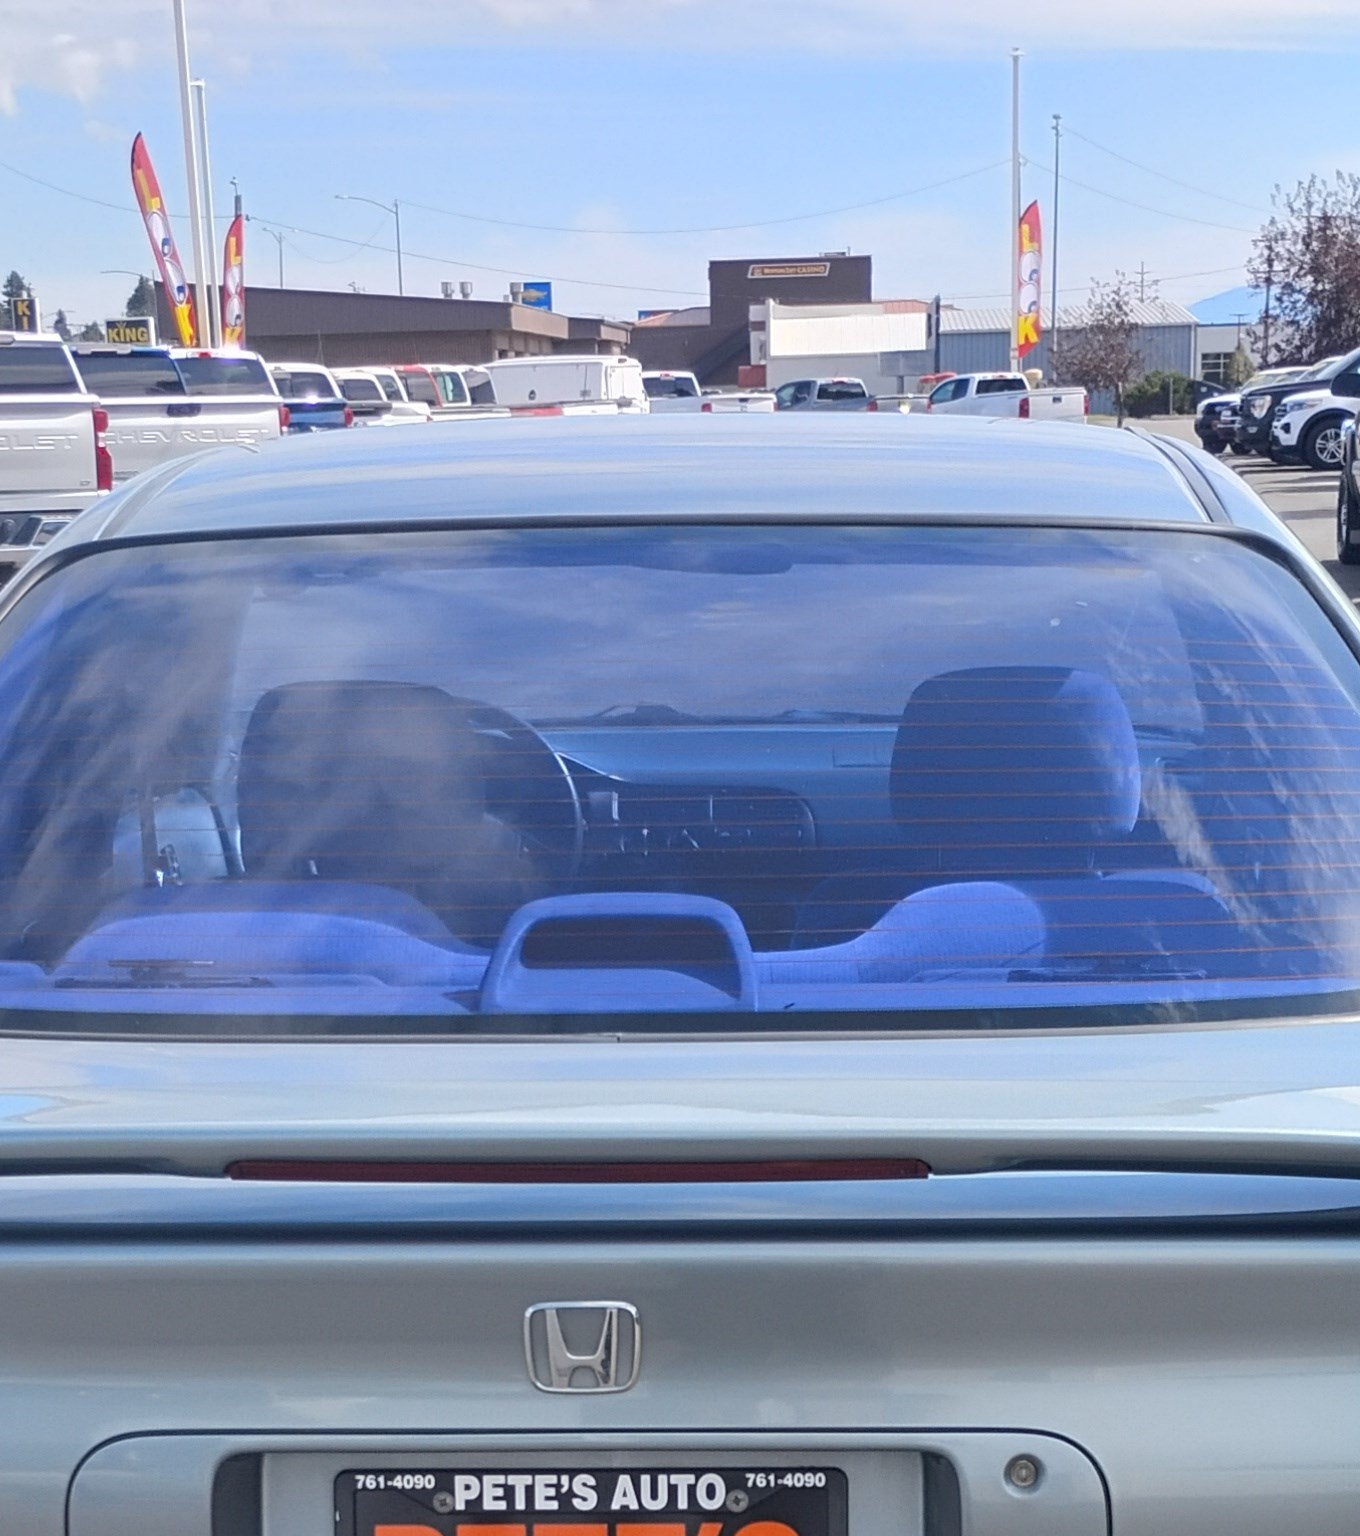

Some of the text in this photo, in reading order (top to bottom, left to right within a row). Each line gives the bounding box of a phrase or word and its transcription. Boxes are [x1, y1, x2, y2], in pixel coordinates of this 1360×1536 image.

[108, 327, 148, 343] KING
[355, 1474, 436, 1490] 761-4090
[744, 1472, 827, 1488] 761-4090
[454, 1473, 727, 1511] PETE'S AUTO
